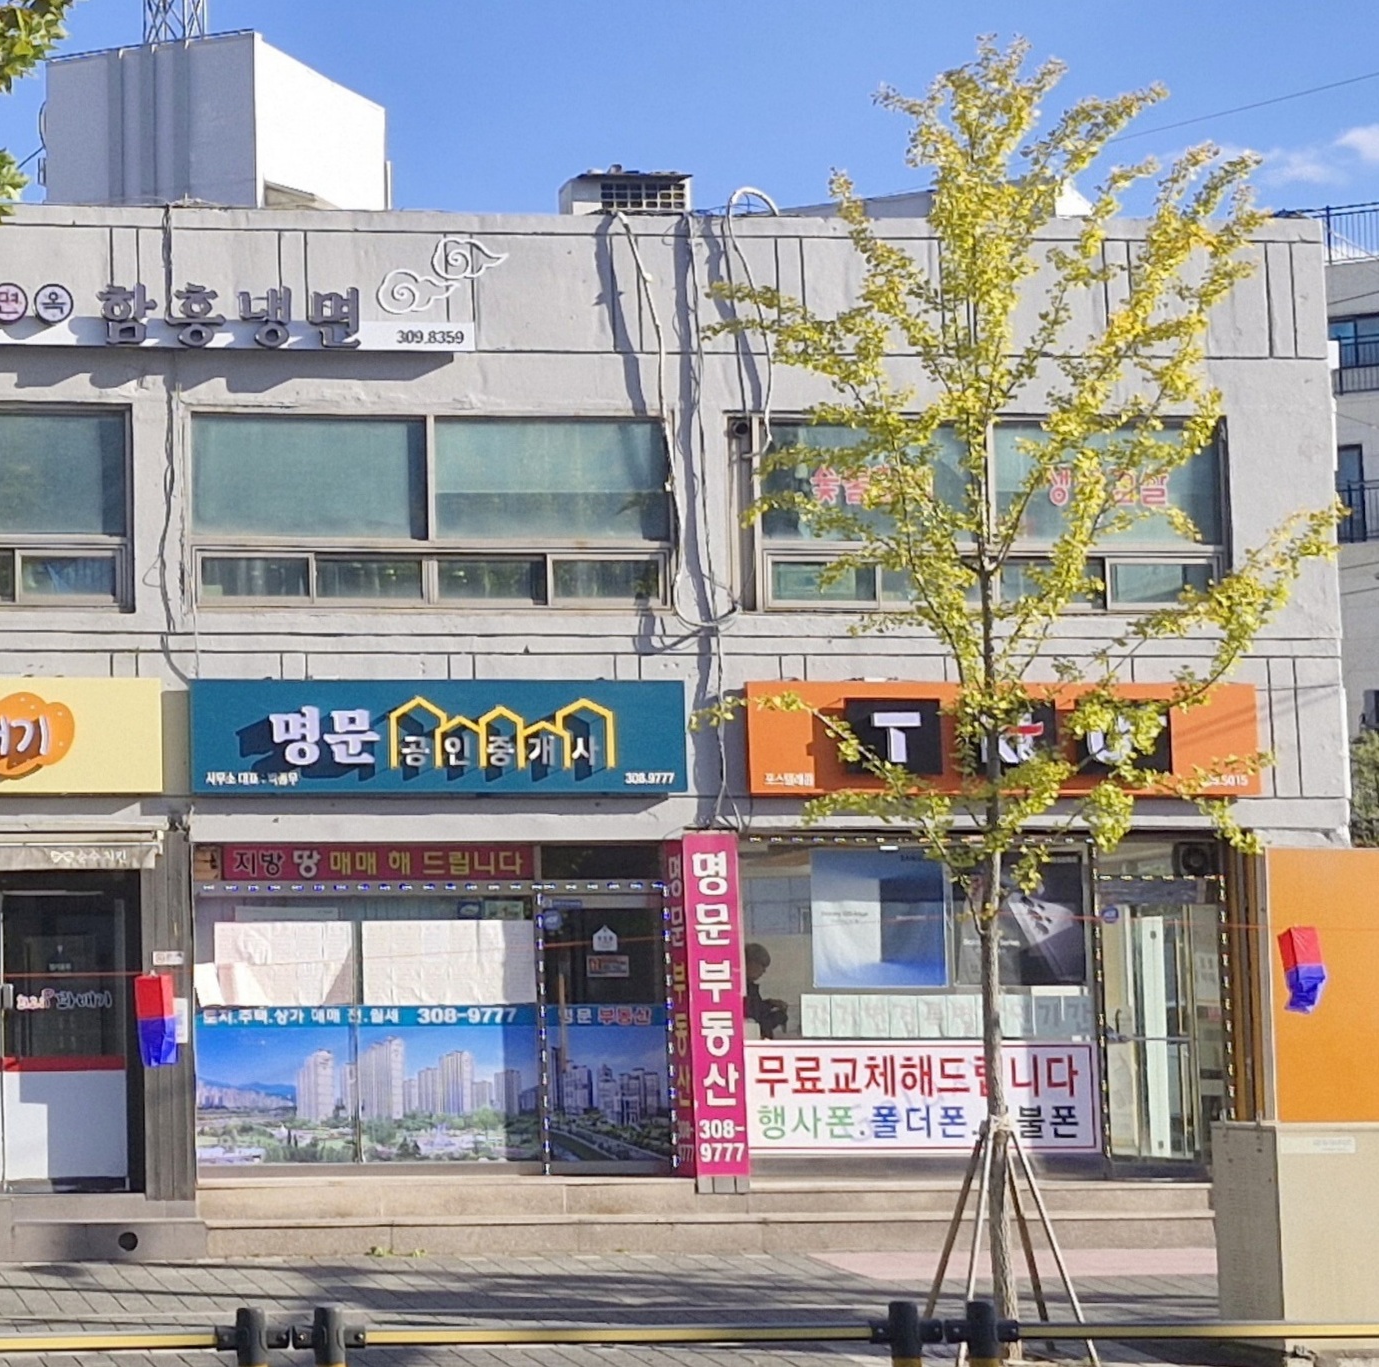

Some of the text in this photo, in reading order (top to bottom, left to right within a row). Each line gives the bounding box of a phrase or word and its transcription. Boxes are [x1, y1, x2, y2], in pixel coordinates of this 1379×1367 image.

[97, 282, 362, 349] 함흥냉면
[396, 329, 464, 345] 309.8359
[269, 705, 600, 767] 명문 공인중개사
[871, 711, 922, 764] T
[205, 771, 237, 786] 사무소
[625, 772, 675, 785] 308.9777
[233, 849, 524, 879] 지방 땅 매매 해 드립니다
[691, 851, 740, 1107] 명문 부동산
[310, 1008, 341, 1024] 매매
[416, 1007, 518, 1024] 308-9777
[596, 1006, 652, 1025] 부동산
[699, 1119, 745, 1139] 308-
[699, 1143, 745, 1163] 9777
